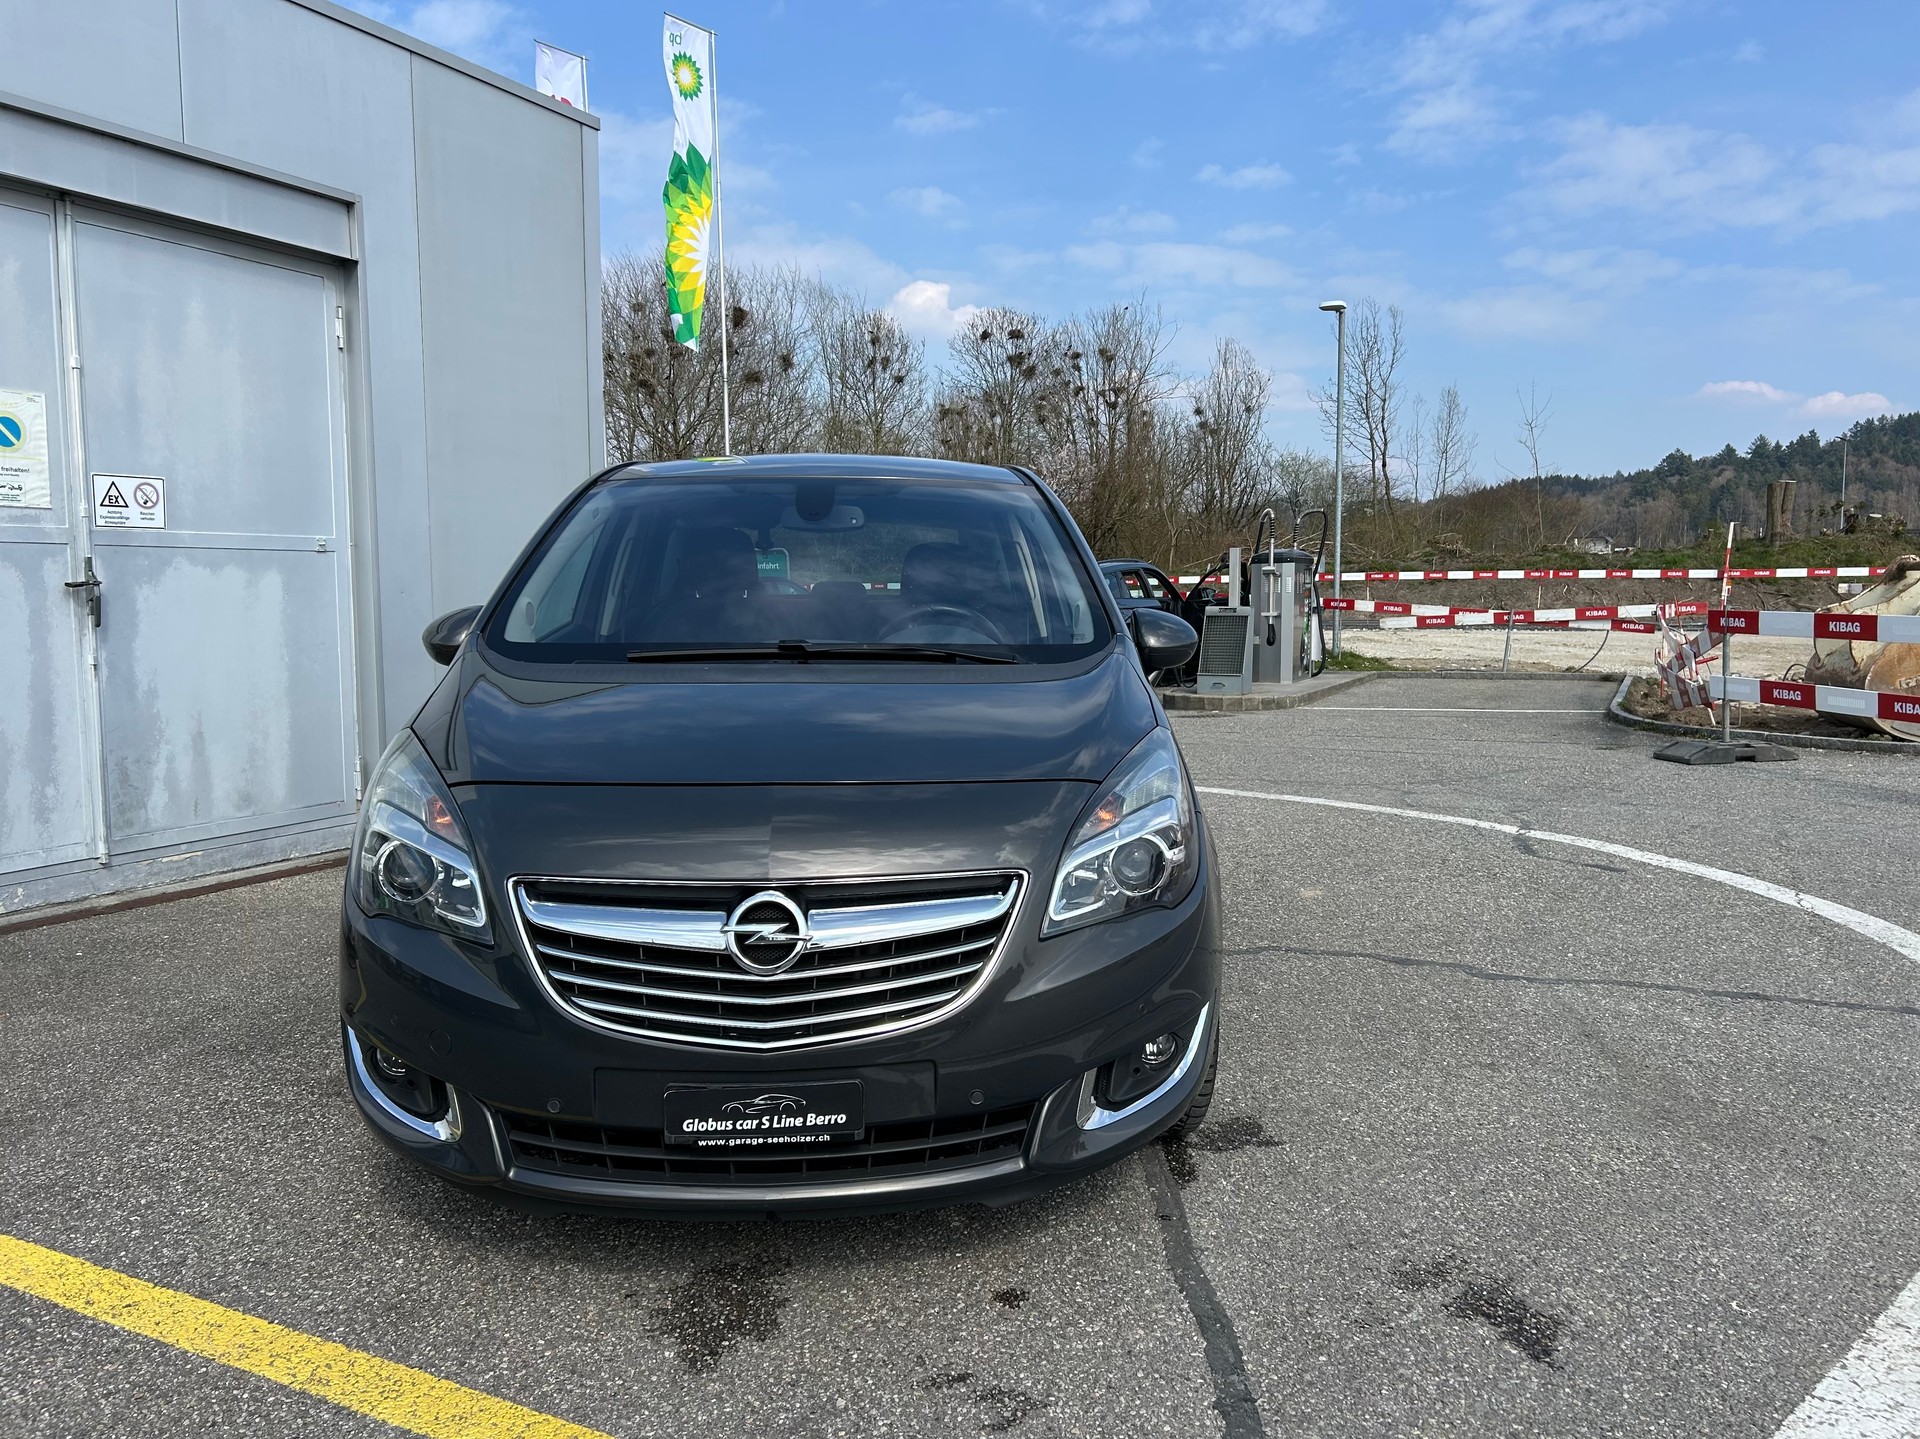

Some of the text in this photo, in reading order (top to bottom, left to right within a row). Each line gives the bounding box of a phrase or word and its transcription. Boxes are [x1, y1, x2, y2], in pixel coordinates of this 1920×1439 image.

[108, 495, 120, 504] EX
[757, 562, 780, 570] infahrt
[1621, 622, 1645, 630] KIBAG
[1829, 621, 1861, 632] KIBAG
[1773, 688, 1801, 701] KIBAG
[1894, 701, 1920, 715] KIBA
[682, 1113, 847, 1132] Globus car S Line Berro
[698, 1134, 830, 1147] www.garage-seeholzer.ch
